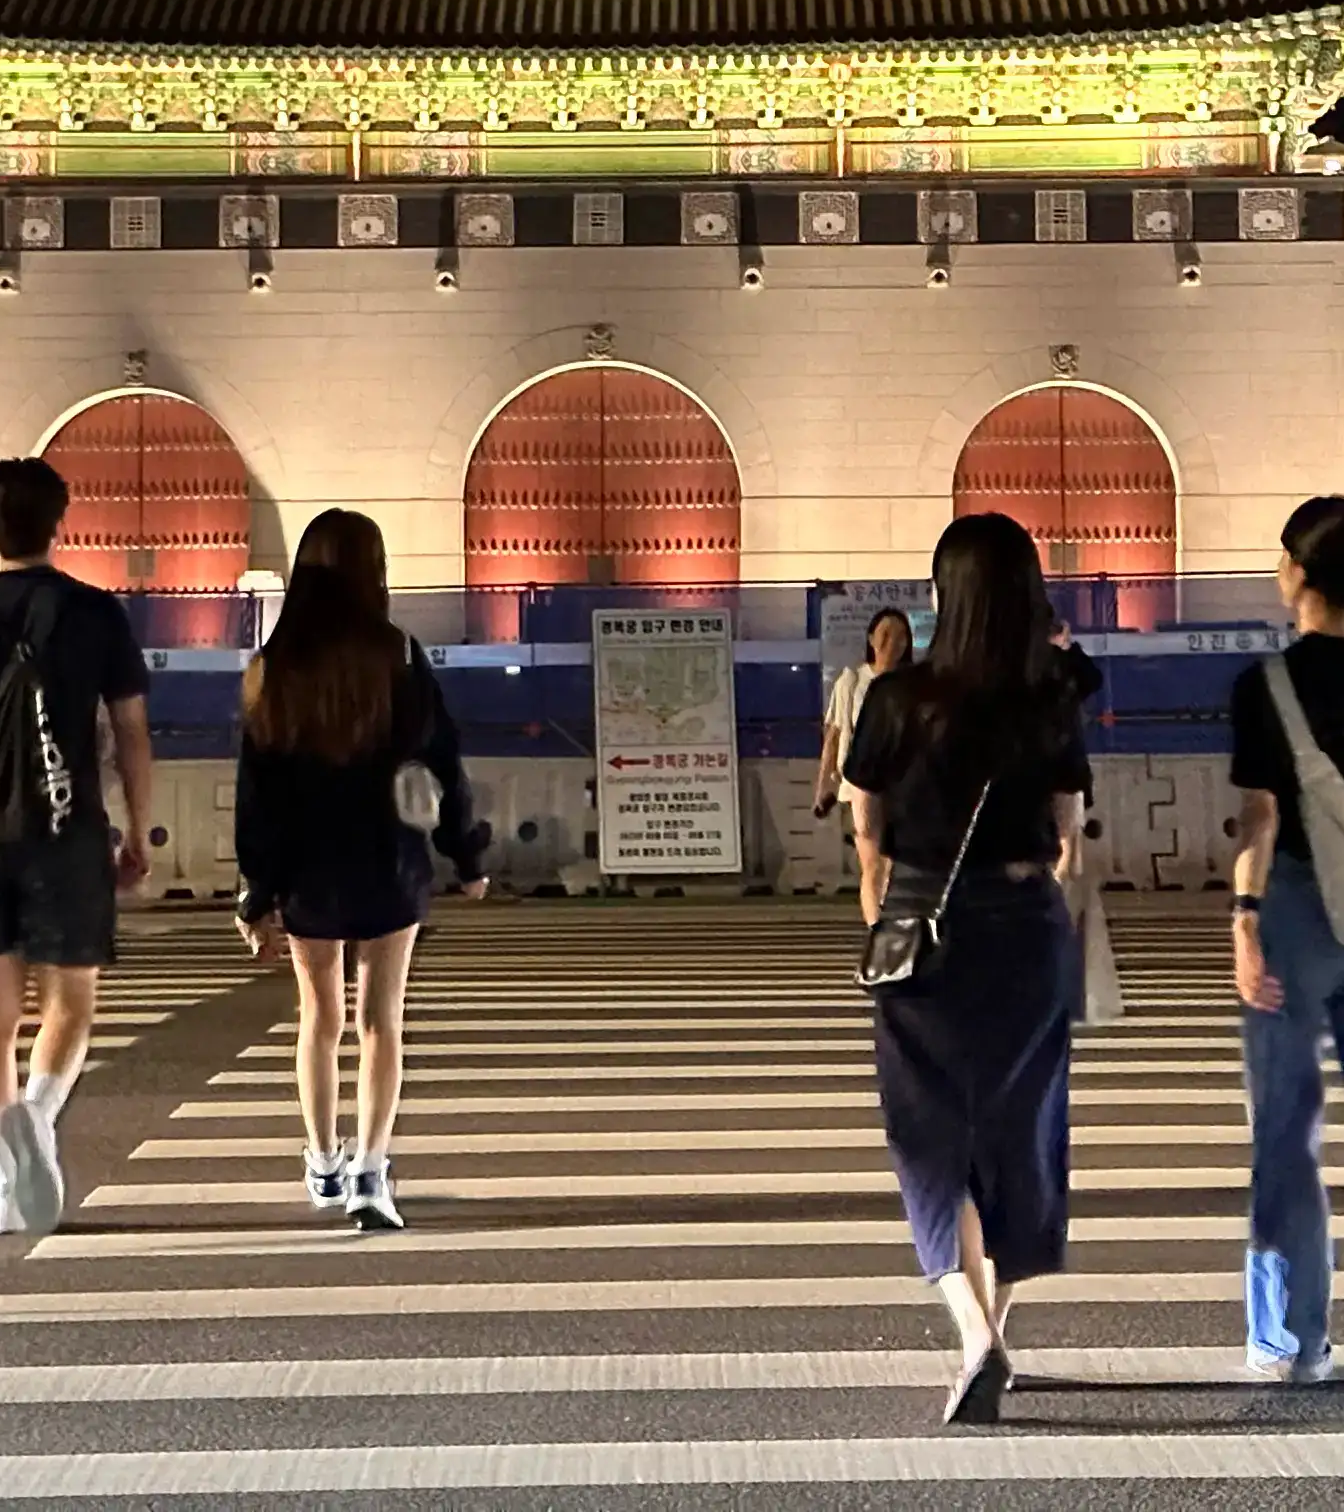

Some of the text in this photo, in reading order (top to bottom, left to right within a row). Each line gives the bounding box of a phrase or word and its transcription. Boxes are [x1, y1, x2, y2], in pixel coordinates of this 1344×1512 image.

[602, 618, 723, 635] 경복궁 입구 변경 안내
[1187, 634, 1226, 652] 안전
[653, 753, 689, 770] 경복궁
